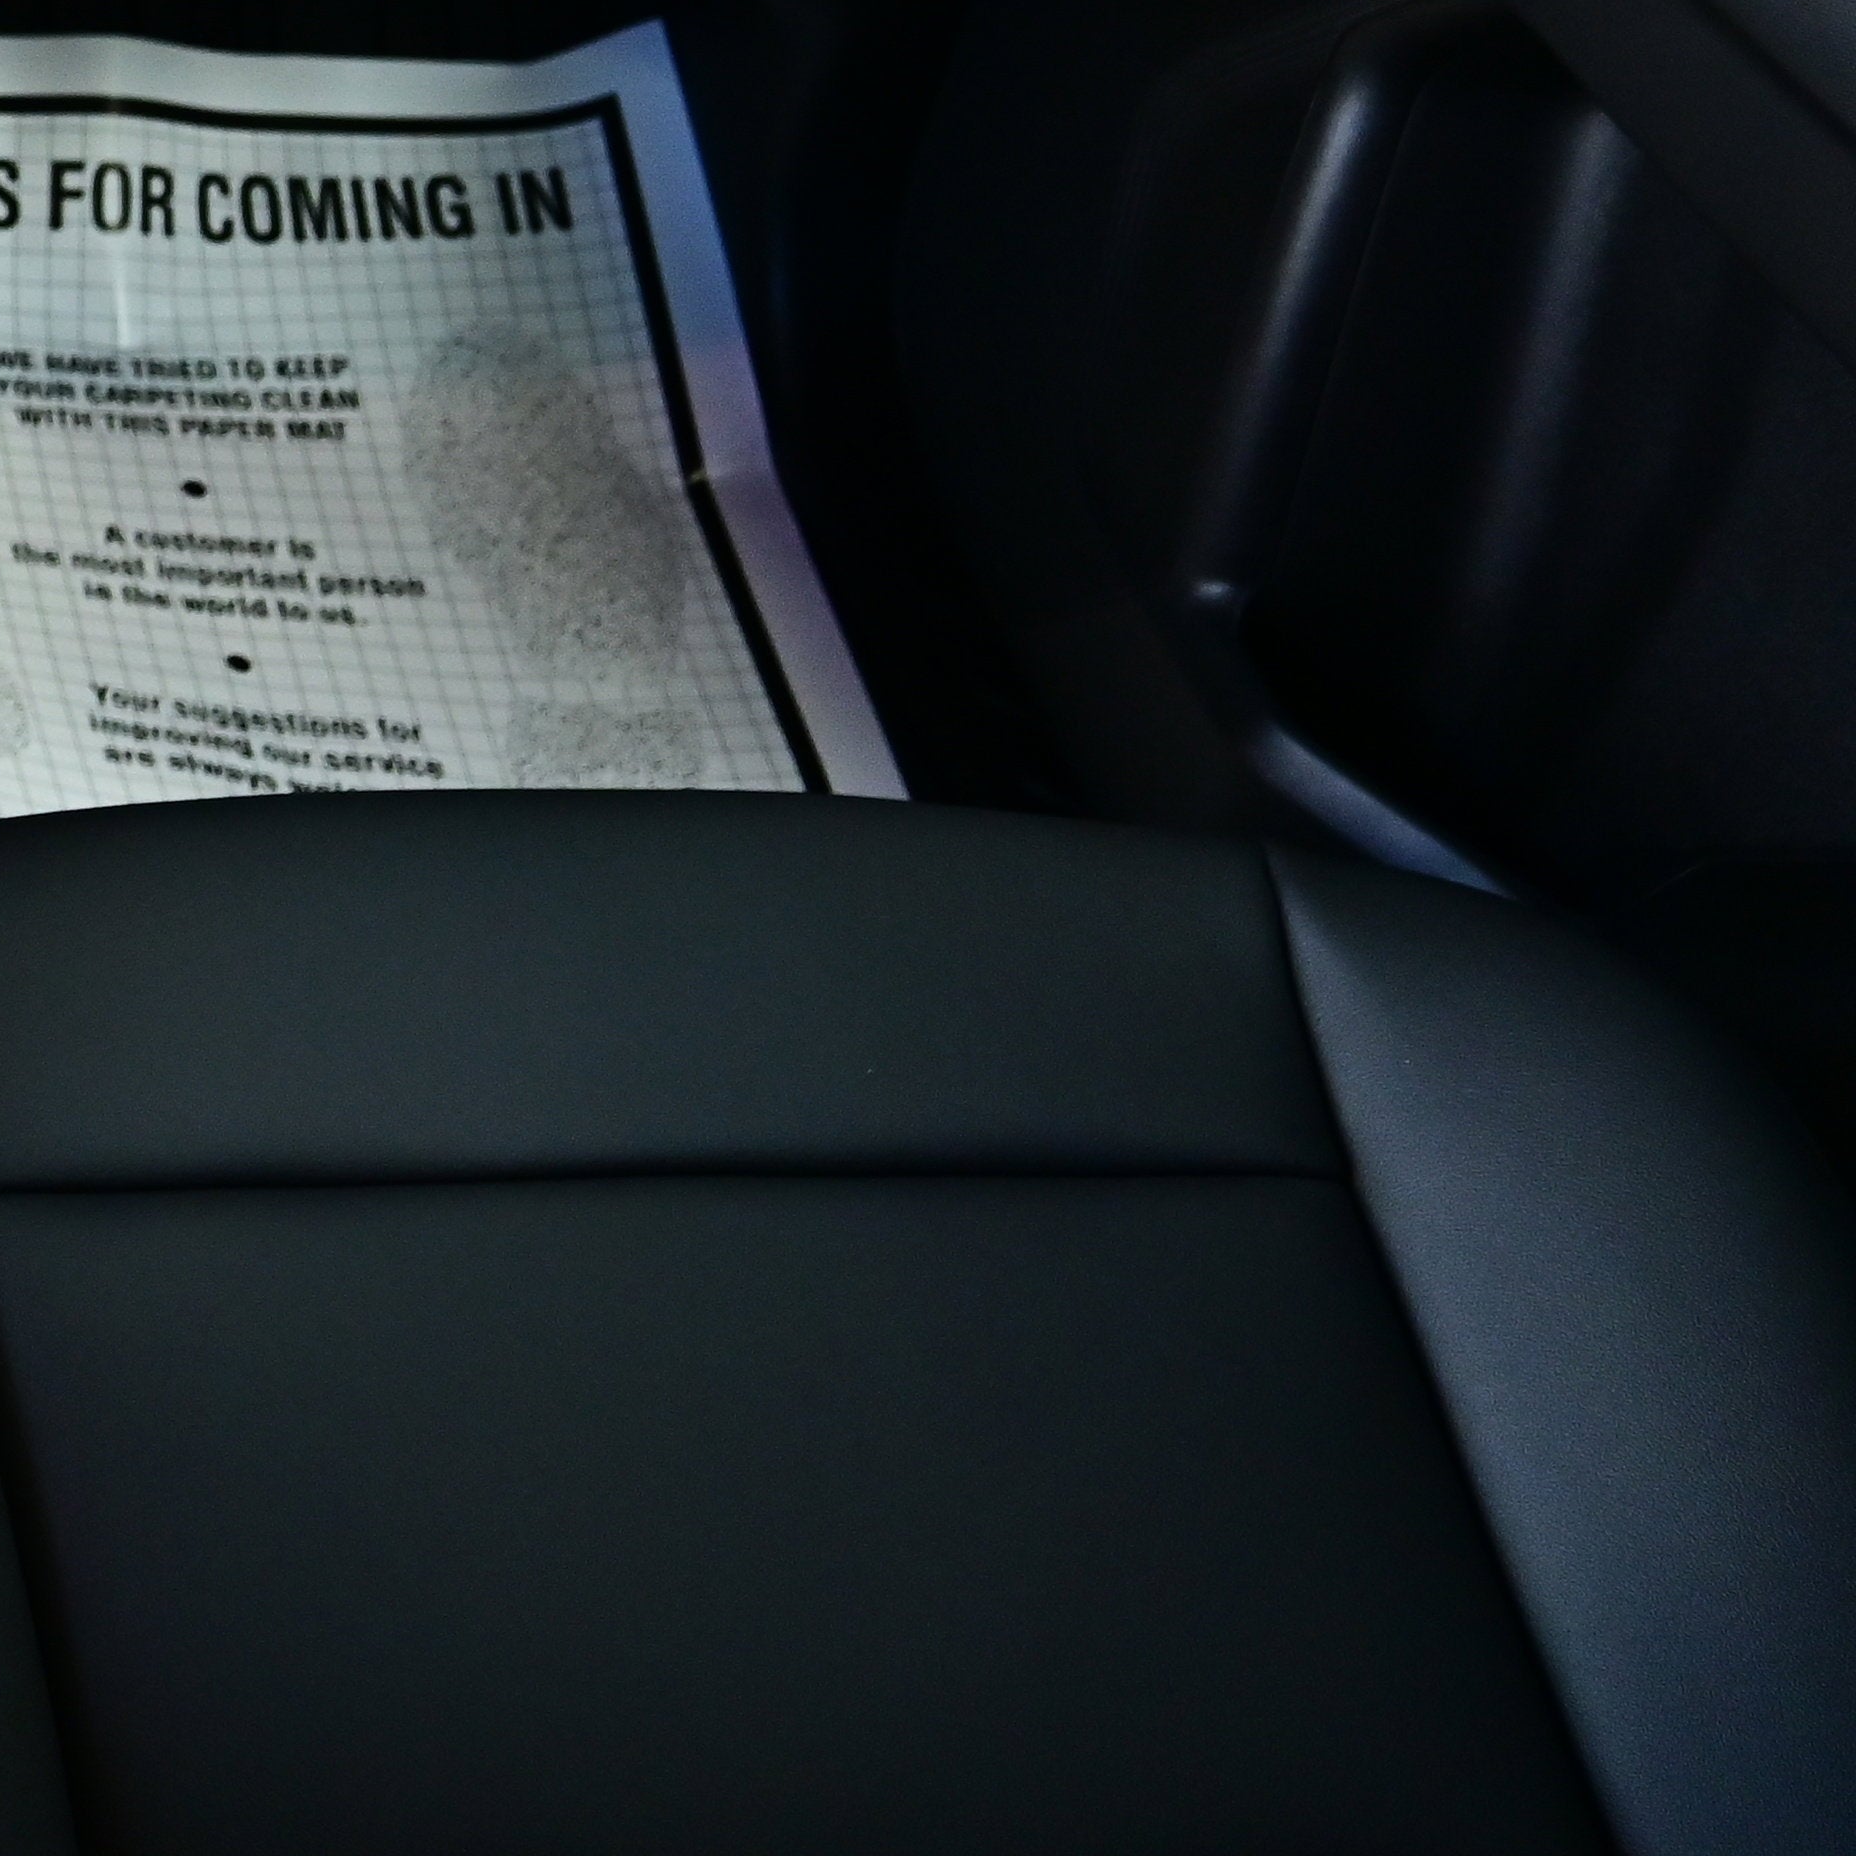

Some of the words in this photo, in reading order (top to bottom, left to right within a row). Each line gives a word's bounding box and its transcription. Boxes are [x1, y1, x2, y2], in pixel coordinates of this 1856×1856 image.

[47, 159, 175, 238] FOR
[197, 170, 474, 245] COMING
[498, 164, 576, 236] IN
[228, 357, 266, 381] TO
[104, 523, 125, 544] A
[135, 530, 276, 558] customer
[288, 540, 316, 561] is
[11, 543, 62, 567] the
[71, 553, 146, 578] most
[159, 561, 307, 591] important
[319, 575, 426, 598] person
[122, 586, 171, 609] the
[185, 596, 269, 619] world
[277, 599, 309, 622] to
[90, 684, 161, 714] Your
[174, 698, 368, 740] suggestions
[377, 717, 421, 742] for
[90, 715, 254, 759] improving
[262, 743, 311, 767] our
[326, 749, 445, 779] service
[104, 745, 155, 767] are
[169, 752, 278, 792] always
